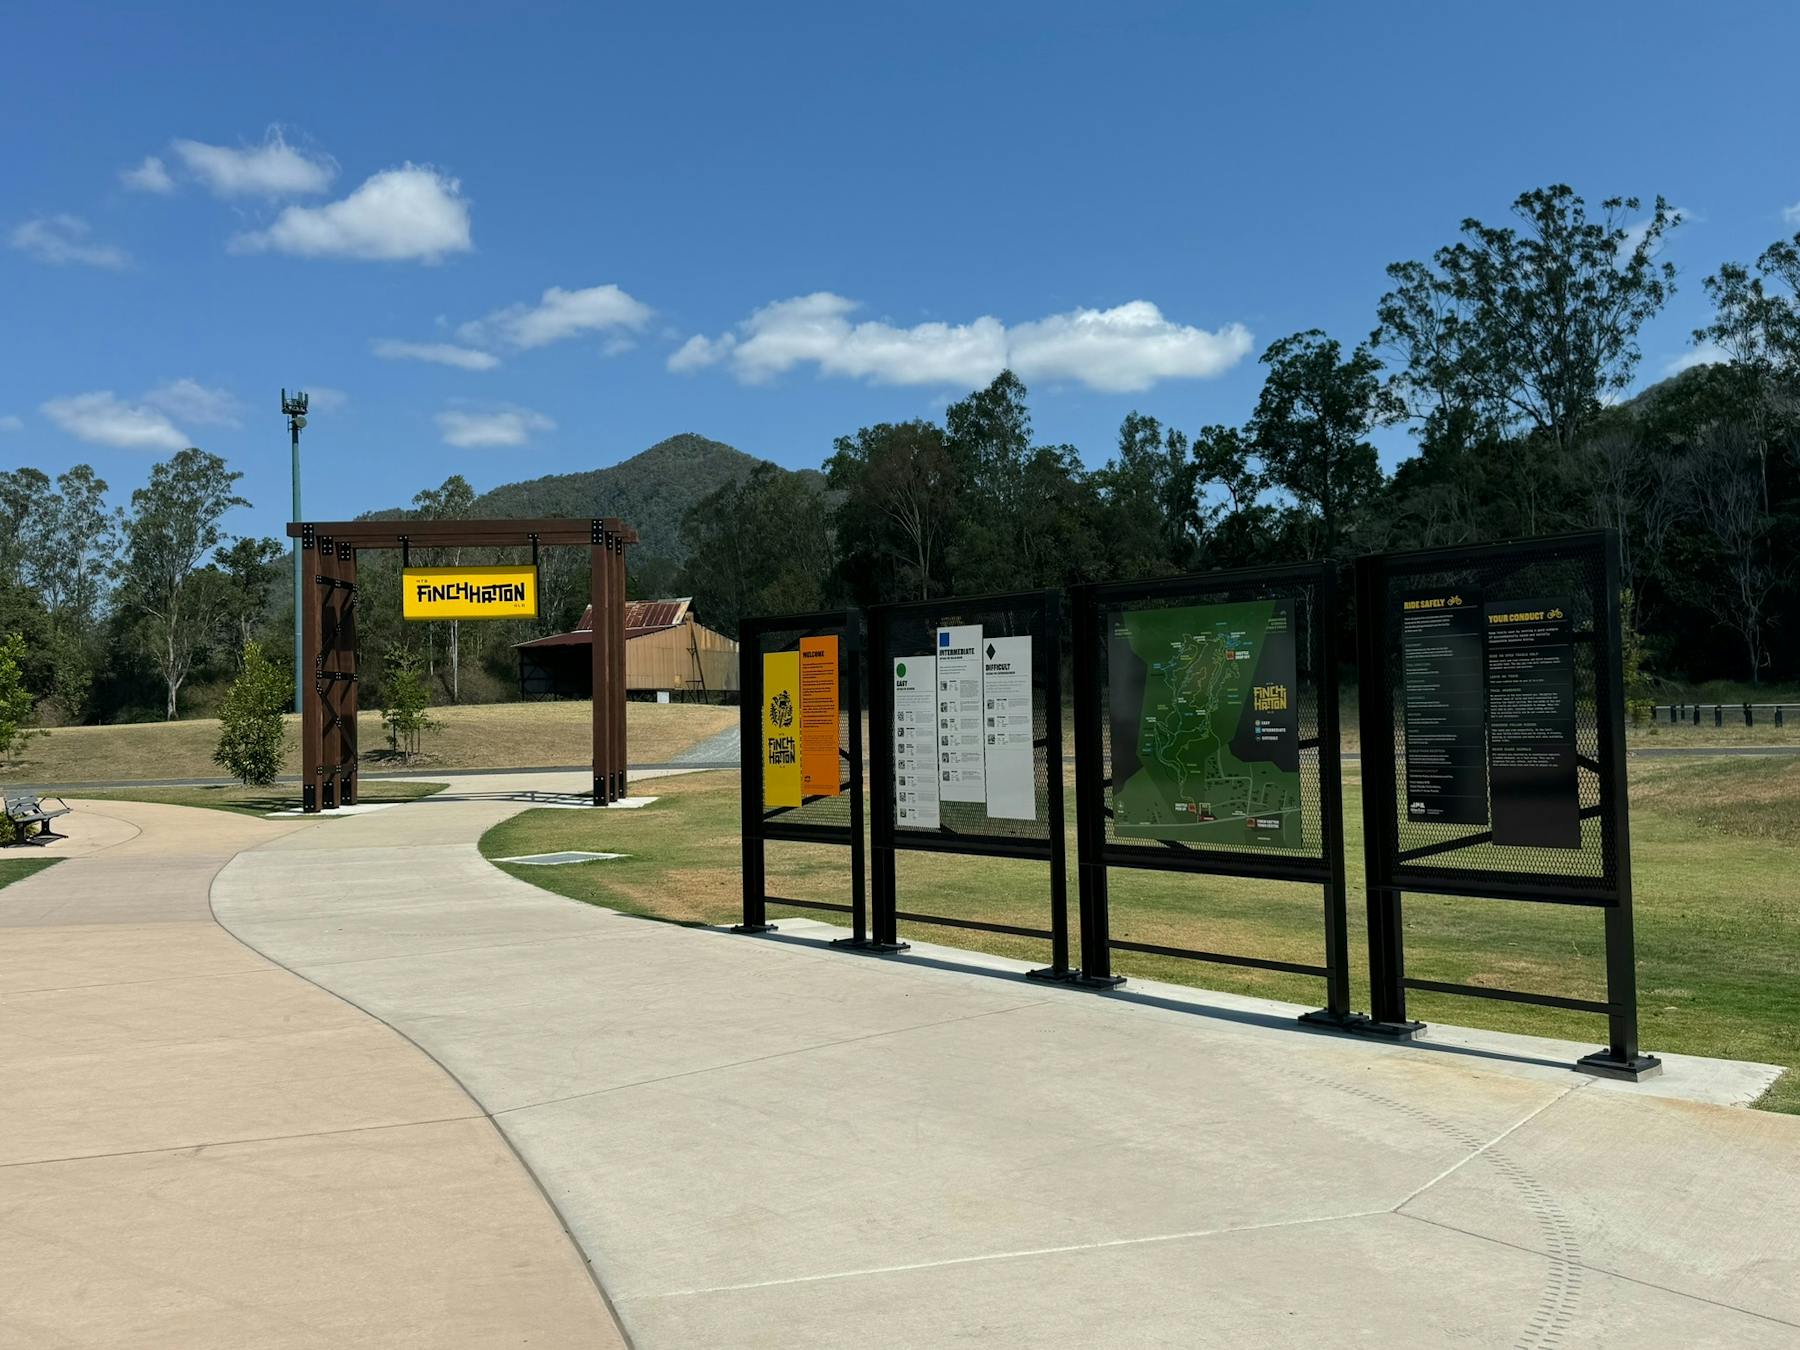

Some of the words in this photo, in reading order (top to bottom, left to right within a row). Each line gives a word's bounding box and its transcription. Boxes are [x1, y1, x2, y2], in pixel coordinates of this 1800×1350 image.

[1403, 601, 1420, 610] RIDE
[1420, 599, 1446, 609] SAFELY
[1488, 614, 1509, 624] YOUR
[1509, 611, 1545, 622] CONDUCT
[802, 650, 825, 658] WELCOME
[939, 648, 975, 656] INTERMEDIATE
[985, 663, 1011, 671] DIFFICULT
[1253, 684, 1287, 698] FINCH
[1254, 696, 1287, 711] HATTON
[768, 736, 795, 750] FINCH
[768, 748, 796, 764] HATTON
